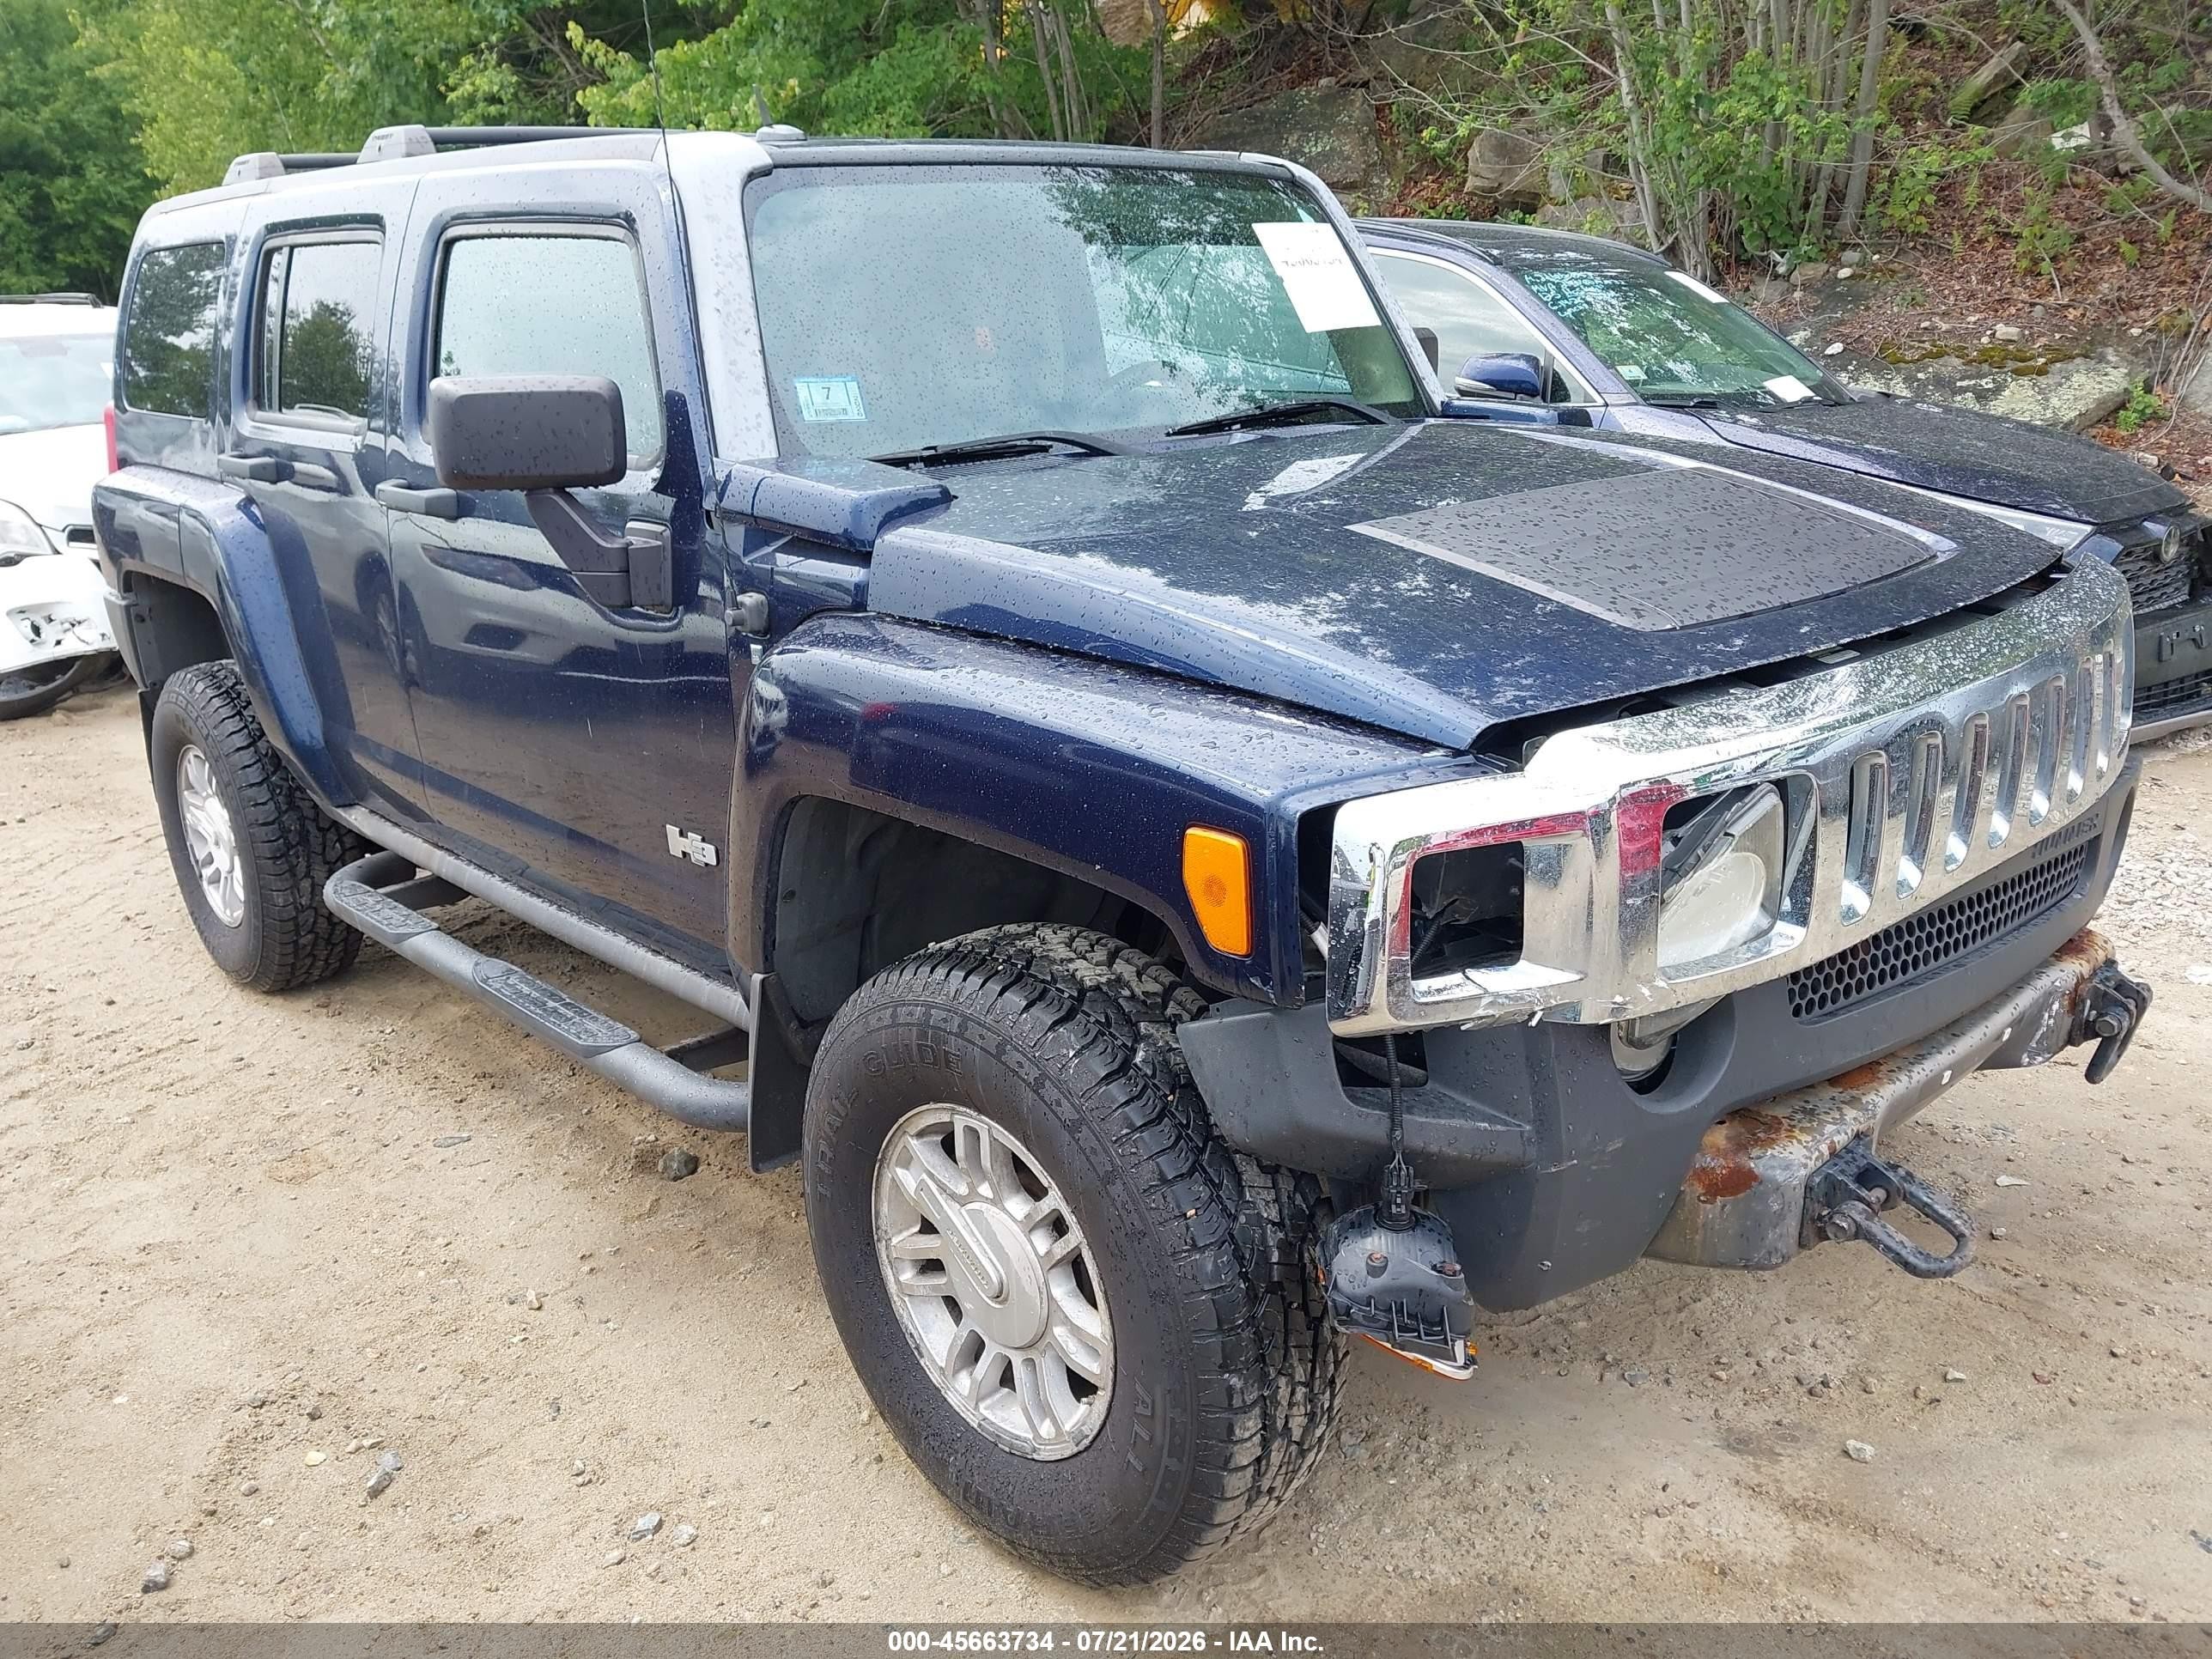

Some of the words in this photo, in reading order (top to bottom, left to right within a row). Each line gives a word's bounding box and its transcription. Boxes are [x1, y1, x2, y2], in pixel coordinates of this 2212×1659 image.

[821, 386, 831, 400] 7
[665, 823, 719, 867] H3
[862, 1037, 963, 1078] GLIDE
[1121, 1376, 1153, 1473] ALL
